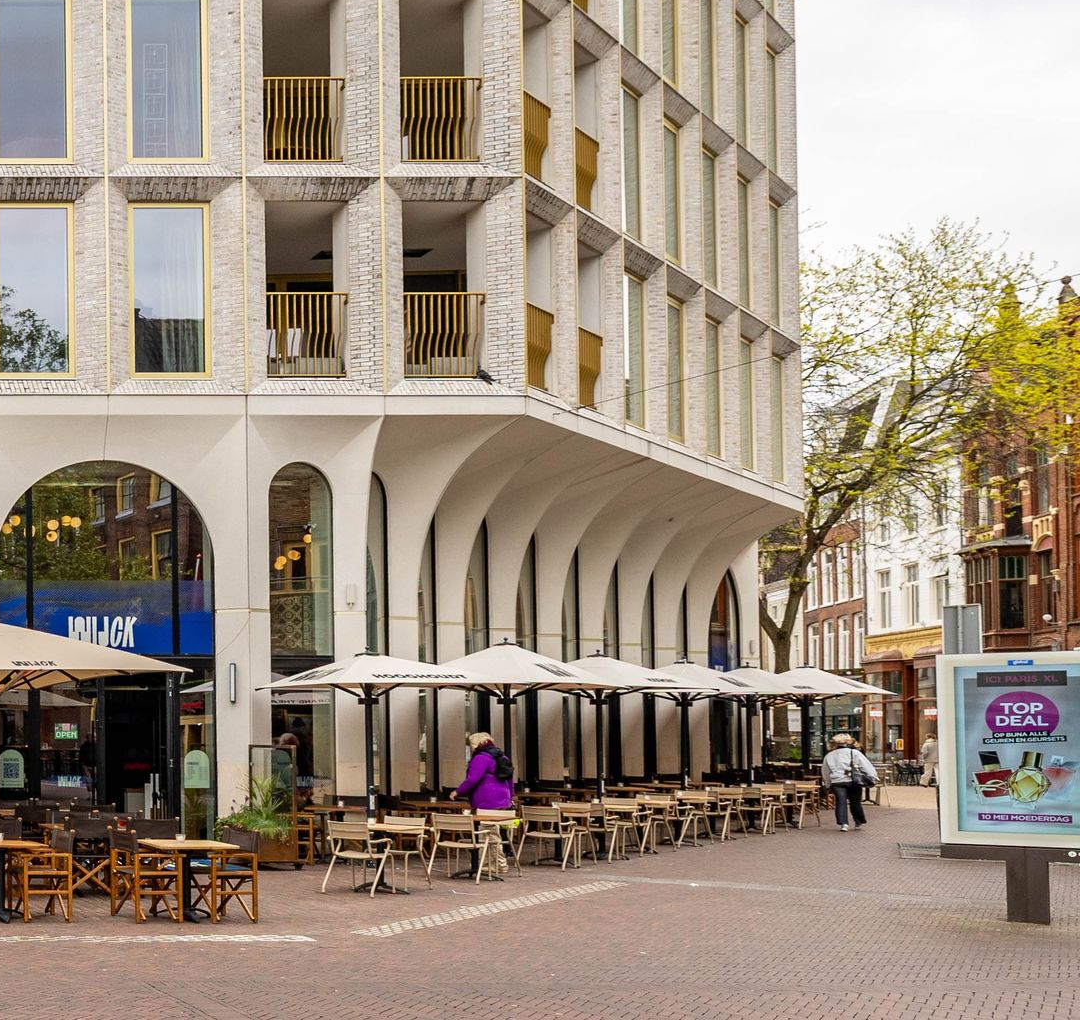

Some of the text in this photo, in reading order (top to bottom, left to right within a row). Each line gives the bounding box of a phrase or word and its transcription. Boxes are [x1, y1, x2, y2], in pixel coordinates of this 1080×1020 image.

[985, 674, 1059, 683] ICI PARIS XL
[999, 702, 1044, 714] TOP
[995, 715, 1049, 727] DEAL
[55, 731, 78, 739] OPEN
[1010, 815, 1070, 823] MOEDERDAG
